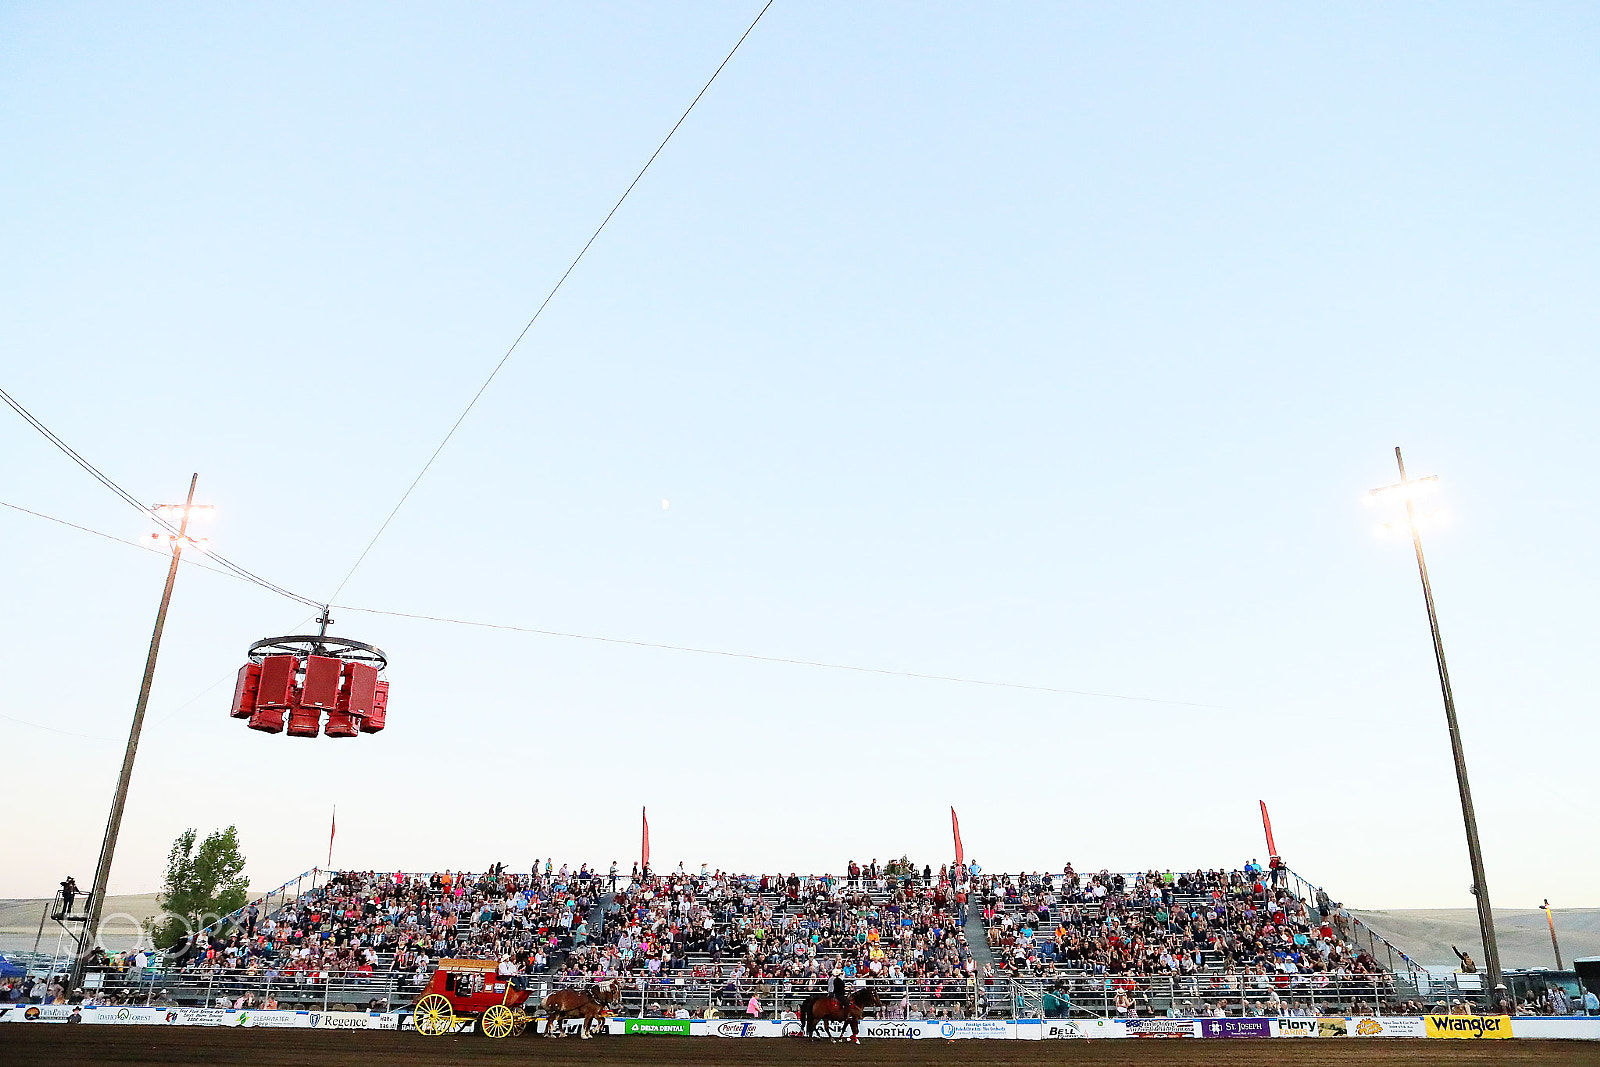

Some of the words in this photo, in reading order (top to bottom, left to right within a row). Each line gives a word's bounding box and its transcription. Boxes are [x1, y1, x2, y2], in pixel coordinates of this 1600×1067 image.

[324, 1015, 367, 1028] Regence
[1237, 1022, 1263, 1032] JOSEPH
[1278, 1019, 1317, 1032] Flory
[1431, 1016, 1501, 1037] Wrangler
[1049, 1027, 1076, 1036] BELL
[1279, 1028, 1308, 1036] FARMS
